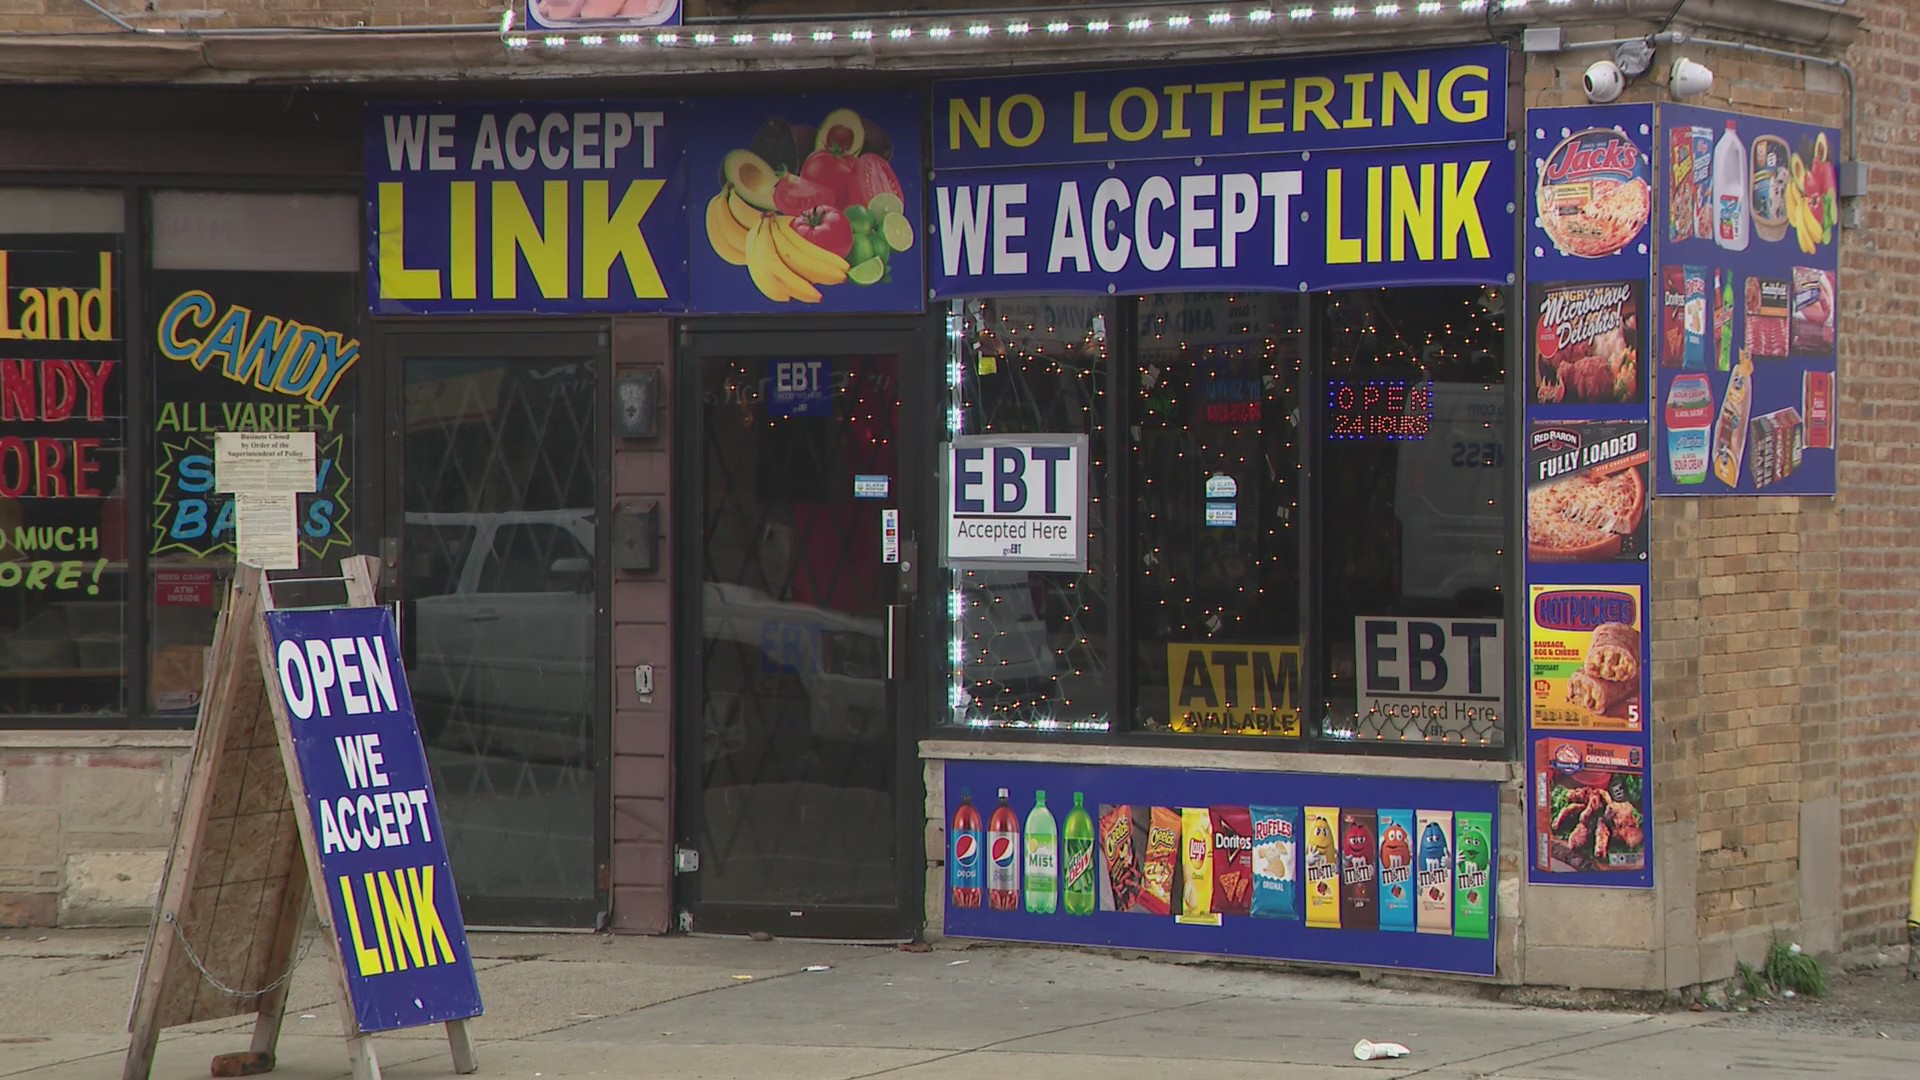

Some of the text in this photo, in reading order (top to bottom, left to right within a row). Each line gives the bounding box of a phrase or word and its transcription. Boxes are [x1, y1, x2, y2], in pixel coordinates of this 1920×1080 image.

[949, 65, 1490, 150] NO LOITERING
[383, 111, 664, 171] WE ACCEPT
[1548, 139, 1638, 180] Jack's
[936, 160, 1492, 276] WE ACCEPT LINK
[378, 178, 669, 299] LINK
[0, 251, 113, 341] Land
[1540, 284, 1631, 327] Microwave
[1557, 302, 1622, 349] Delights!
[157, 289, 361, 407] CANDY
[0, 359, 115, 422] NDY
[777, 362, 822, 391] EBT
[1338, 386, 1429, 411] OPEN
[155, 402, 341, 434] ALL VARIETY
[1335, 415, 1429, 435] 24 HOURS
[228, 450, 276, 458] Superintendent
[1534, 433, 1550, 445] RED
[1540, 450, 1580, 480] FULLY
[1583, 432, 1638, 466] LOADED
[0, 437, 103, 498] ORE
[954, 446, 1071, 514] EBT
[14, 526, 99, 552] MUCH
[958, 520, 1067, 542] Accepted Here
[0, 557, 109, 596] ORE!
[174, 586, 193, 594] ATM
[167, 594, 201, 602] INSIDE
[1540, 595, 1632, 625] HOT POCKETS
[1364, 620, 1497, 694] EBT
[278, 635, 398, 720] OPEN
[1178, 650, 1299, 711] ATM
[1187, 710, 1294, 732] AVAILABLE
[1373, 699, 1495, 721] Accepted Here
[1628, 705, 1639, 723] 5
[334, 734, 390, 790] WE
[1586, 755, 1629, 766] CHICKEN WINGS
[319, 789, 433, 854] ACCEPT
[1105, 815, 1130, 861] Cheetos
[1150, 827, 1176, 848] Cheetos
[1255, 818, 1293, 841] RUFFLES
[1190, 838, 1206, 861] Lay's
[1215, 832, 1252, 850] Doritos
[956, 868, 977, 881] pepsi
[1029, 853, 1054, 867] Mist
[339, 864, 457, 977] LINK
